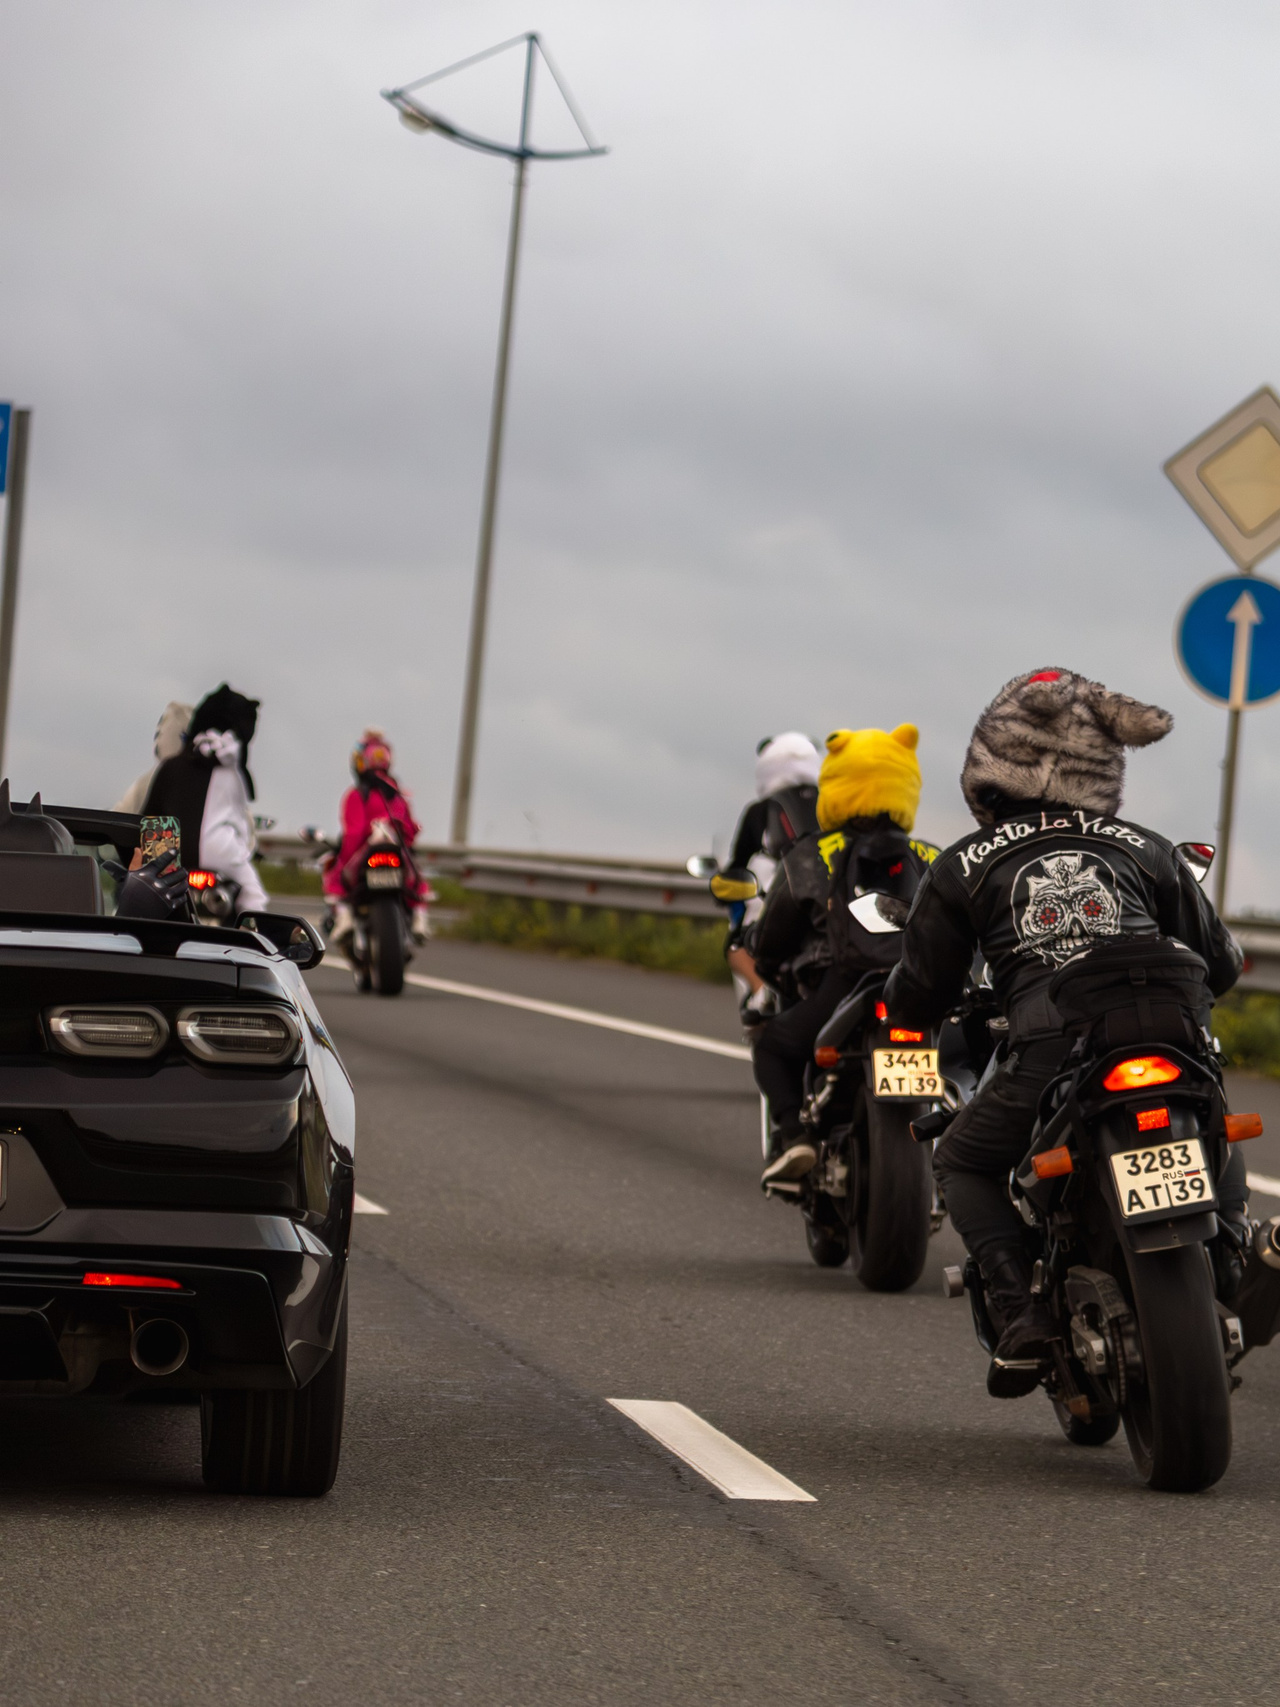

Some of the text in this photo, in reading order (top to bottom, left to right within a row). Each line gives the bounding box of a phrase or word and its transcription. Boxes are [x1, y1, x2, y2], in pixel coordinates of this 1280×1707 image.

[956, 821, 1035, 877] Hasta
[1040, 811, 1072, 831] La
[1073, 810, 1146, 849] Vista
[883, 1053, 931, 1069] 3441
[878, 1077, 938, 1093] AT 39
[1123, 1144, 1192, 1176] 3283
[1162, 1169, 1184, 1181] RUS
[1127, 1177, 1206, 1213] AT 39
